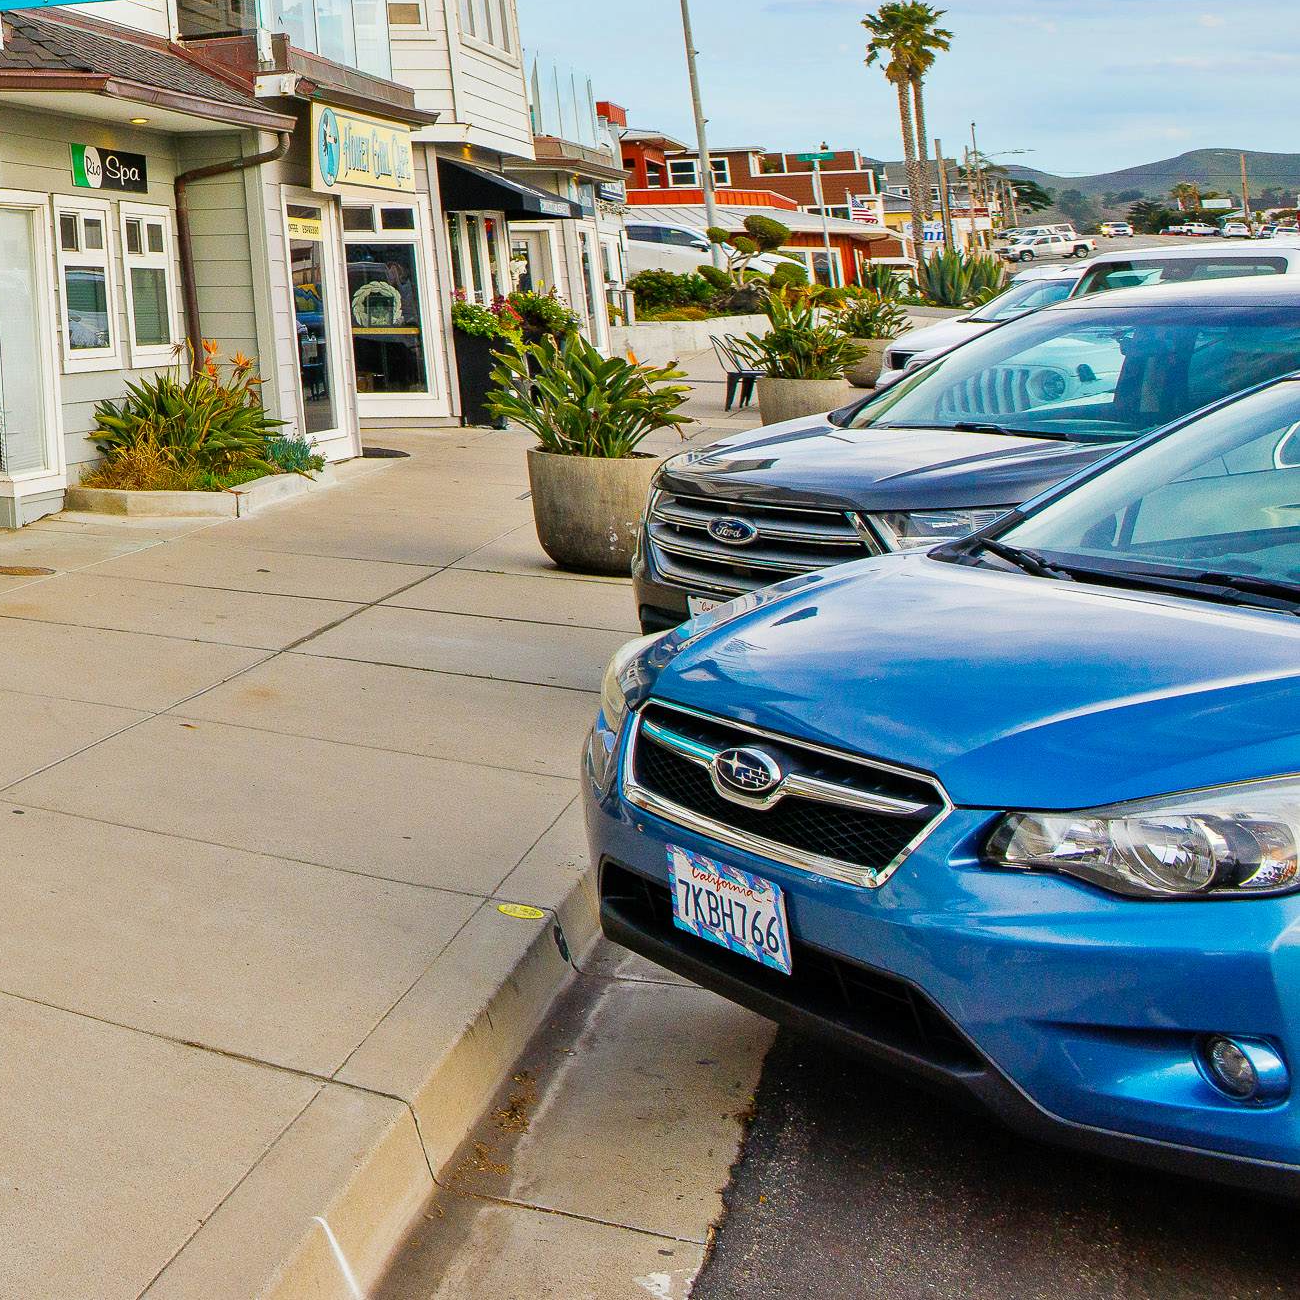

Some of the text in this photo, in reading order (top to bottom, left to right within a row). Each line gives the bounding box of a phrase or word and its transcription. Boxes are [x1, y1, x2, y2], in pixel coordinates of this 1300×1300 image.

[85, 155, 140, 186] Rio Spa
[715, 521, 742, 538] Ford
[691, 867, 761, 903] California
[678, 878, 780, 954] 7KBH766
